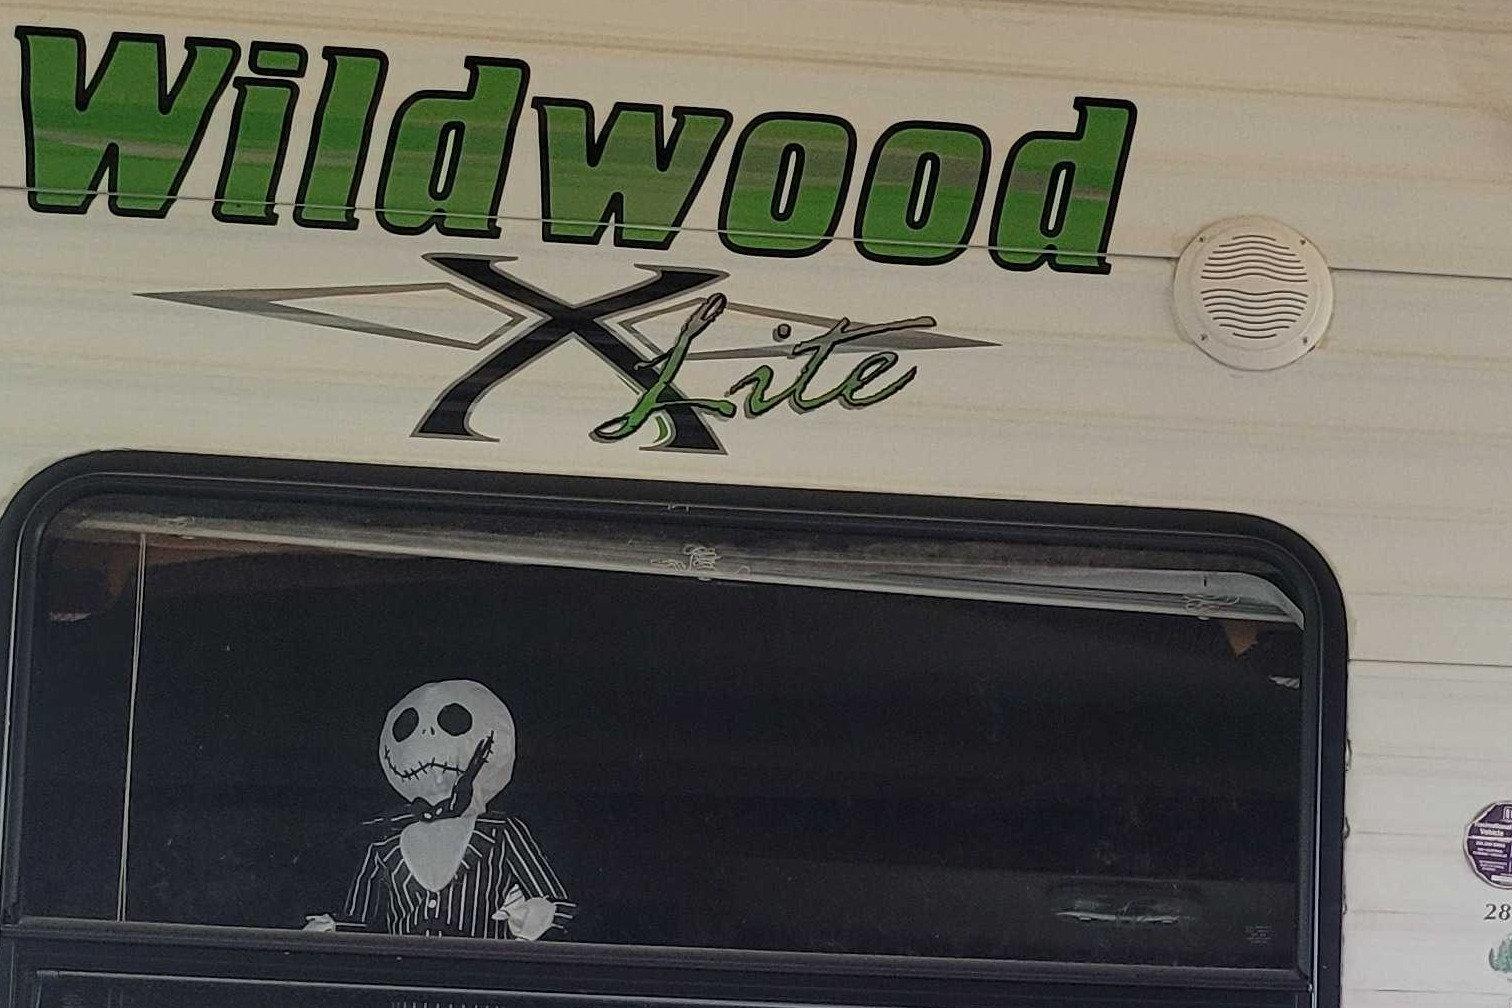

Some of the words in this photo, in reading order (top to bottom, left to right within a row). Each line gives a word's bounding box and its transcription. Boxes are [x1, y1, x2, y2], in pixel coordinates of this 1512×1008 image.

[14, 25, 1138, 275] Wildwood
[589, 293, 937, 443] Lite
[1483, 903, 1511, 920] 28
